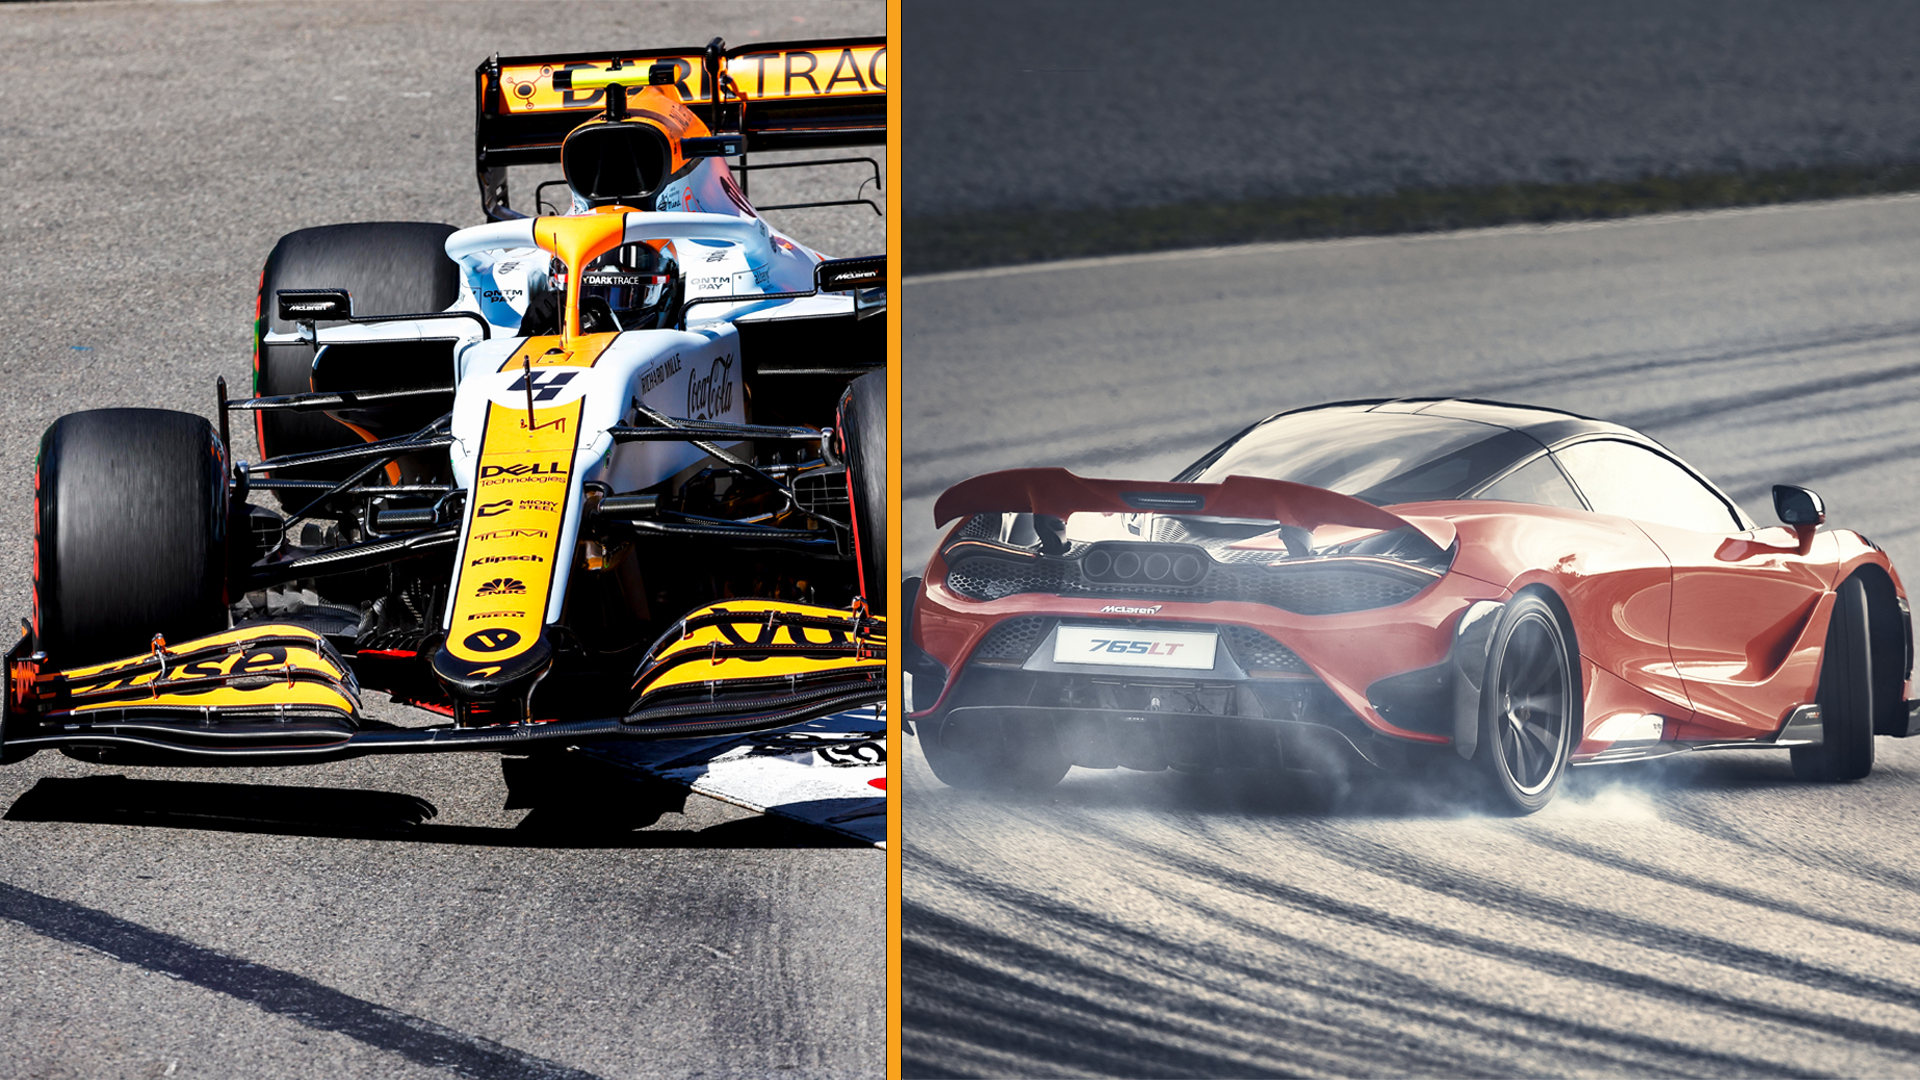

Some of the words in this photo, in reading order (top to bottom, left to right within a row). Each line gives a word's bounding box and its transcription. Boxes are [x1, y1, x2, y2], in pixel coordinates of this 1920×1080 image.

[562, 49, 886, 108] DRTRAC
[588, 276, 640, 285] DARKTRACE
[480, 462, 567, 479] DELL
[480, 475, 566, 487] Technologies
[471, 554, 544, 567] Klipsch
[1100, 605, 1162, 615] McLaren
[1089, 639, 1184, 656] 765LT
